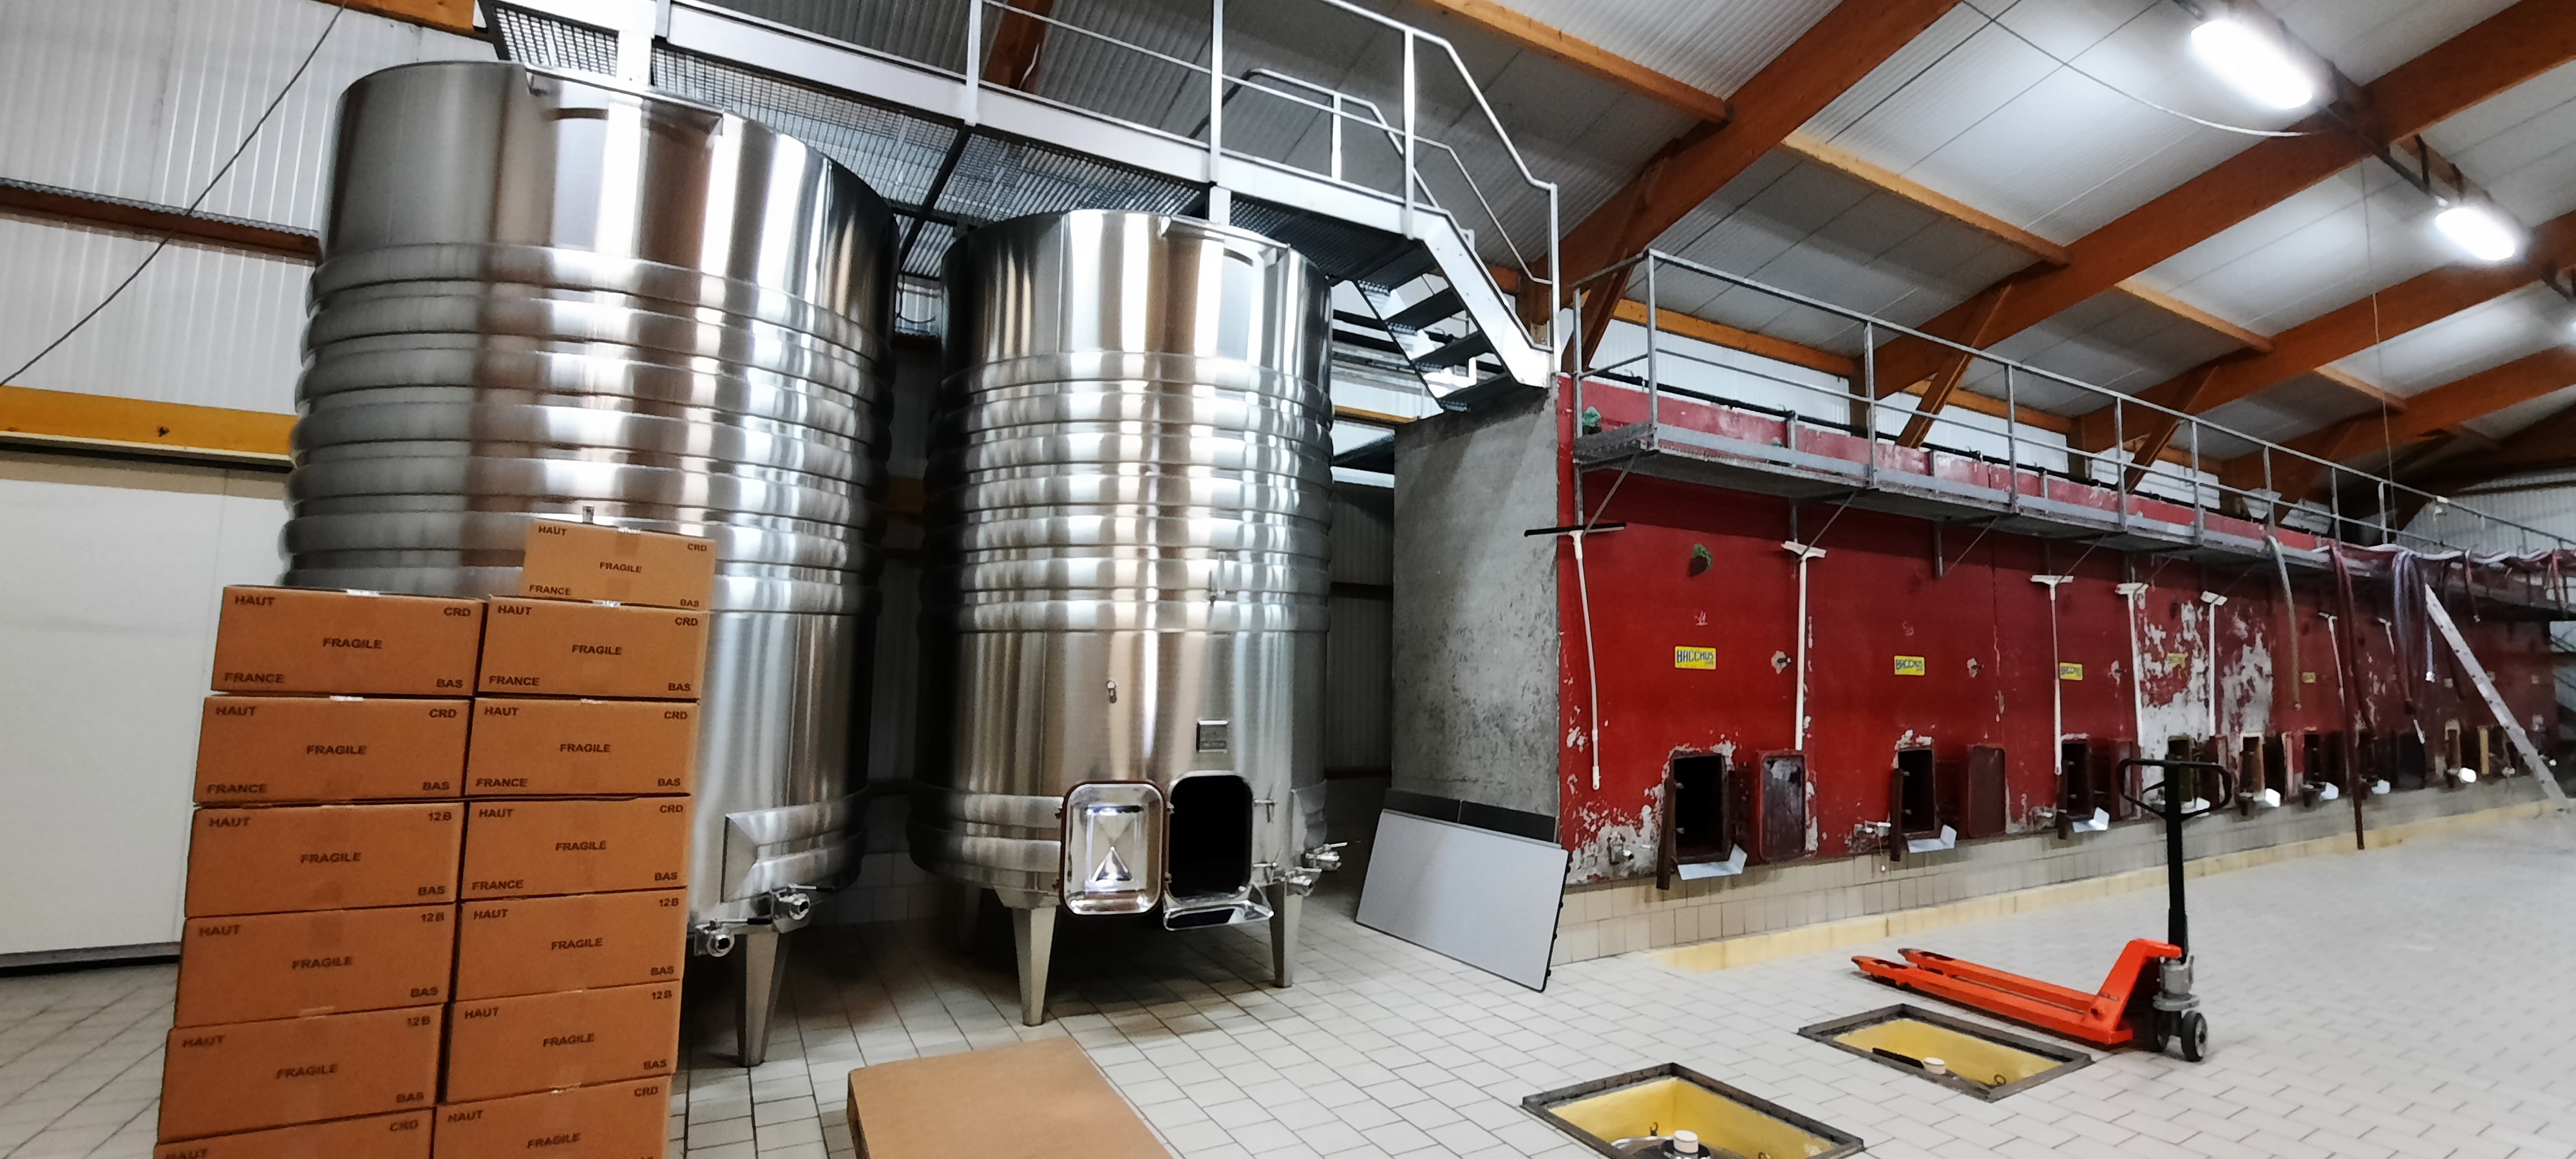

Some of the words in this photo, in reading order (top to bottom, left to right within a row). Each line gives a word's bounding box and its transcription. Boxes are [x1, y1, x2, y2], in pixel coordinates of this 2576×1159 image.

[538, 525, 567, 536] HAUT
[600, 562, 641, 573] FRAGILE
[529, 585, 571, 596] FRANCE
[235, 596, 275, 606] HAUT
[680, 599, 699, 607] BAS
[444, 607, 471, 616] CRD
[498, 605, 532, 615] HAUT
[675, 617, 698, 626] CRD
[323, 638, 382, 649] FRAGILE
[572, 645, 621, 655] FRAGILE
[1677, 650, 1714, 663] BACCHUS
[225, 673, 284, 683] FRANCE
[489, 675, 539, 686] FRANCE
[436, 679, 463, 688] BAS
[668, 683, 690, 692] BAS
[216, 706, 256, 716] HAUT
[429, 709, 457, 718] CRD
[484, 707, 518, 716] HAUT
[307, 745, 366, 755] FRAGILE
[560, 744, 611, 753] FRAGILE
[422, 782, 450, 791] BAS
[476, 778, 527, 787] FRANCE
[207, 784, 267, 793] FRANCE
[479, 809, 513, 818] HAUT
[659, 804, 683, 813] CRD
[209, 817, 251, 827] HAUT
[556, 840, 606, 851] FRAGILE
[300, 853, 361, 863] FRAGILE
[655, 872, 677, 881] BAS
[472, 880, 524, 890] FRANCE
[418, 886, 445, 896] BAS
[474, 909, 508, 919] HAUT
[199, 925, 240, 936] HAUT
[551, 938, 602, 950] FRAGILE
[292, 957, 354, 969] FRAGILE
[651, 966, 674, 975] BAS
[411, 986, 438, 997] BAS
[465, 1007, 498, 1019] HAUT
[182, 1035, 225, 1048] HAUT
[543, 1033, 594, 1047] FRAGILE
[643, 1059, 667, 1069] BAS
[276, 1064, 337, 1079] FRAGILE
[634, 1086, 658, 1097] CRD
[396, 1092, 424, 1103] BAS
[448, 1110, 483, 1122] HAUT
[389, 1119, 419, 1131] CRD
[527, 1133, 580, 1149] FRAGILE
